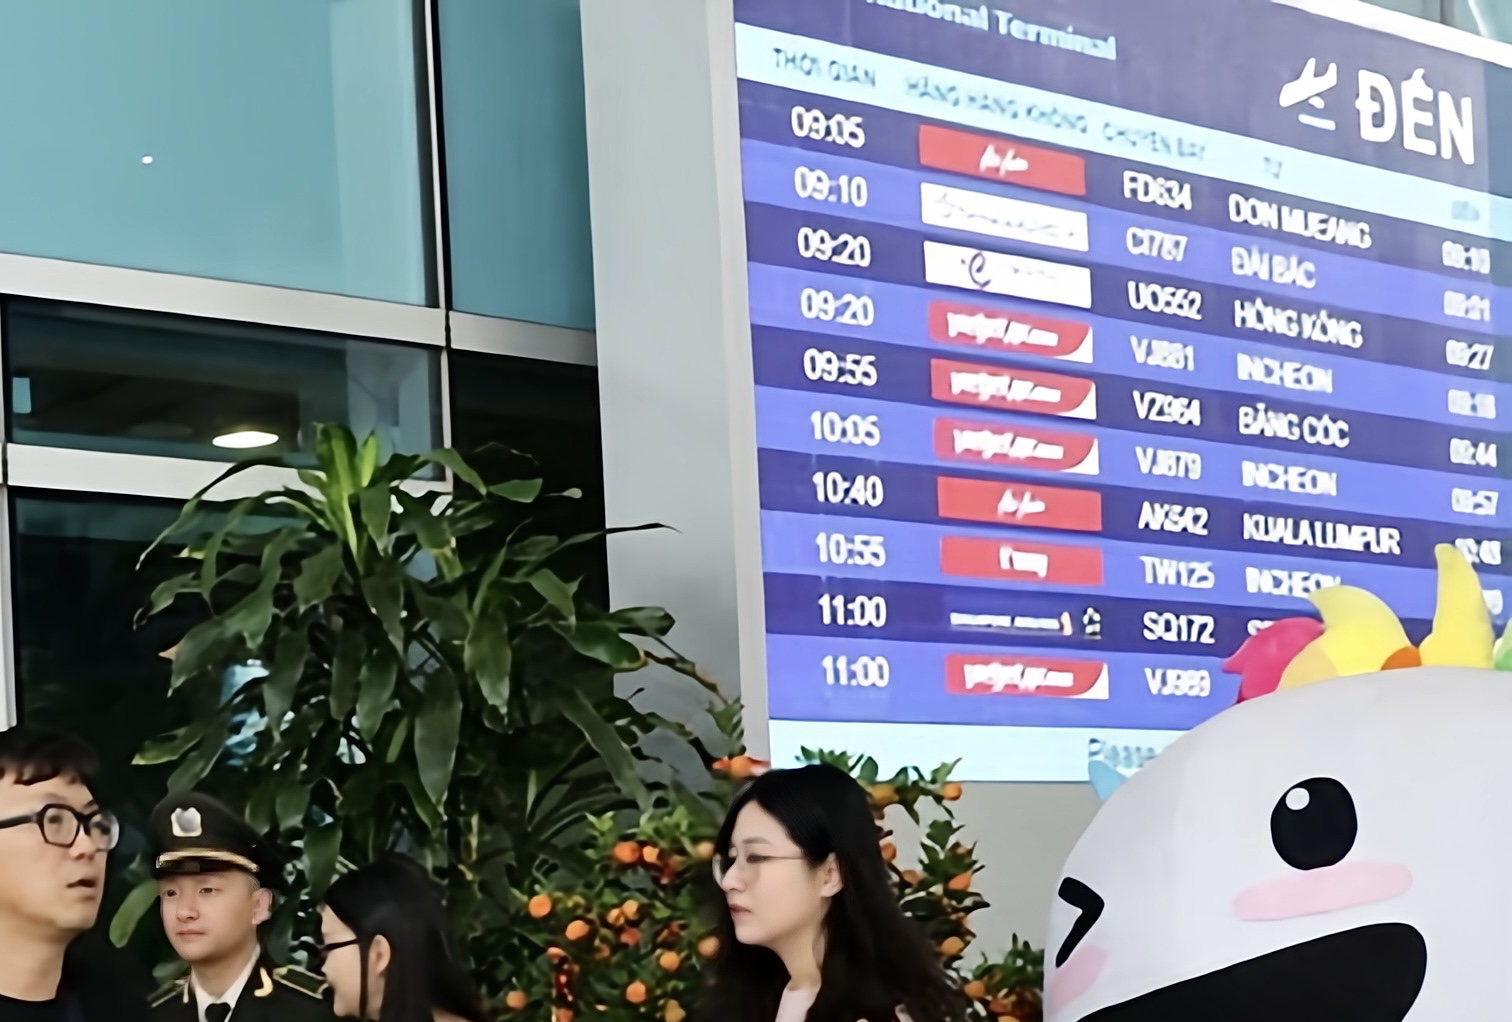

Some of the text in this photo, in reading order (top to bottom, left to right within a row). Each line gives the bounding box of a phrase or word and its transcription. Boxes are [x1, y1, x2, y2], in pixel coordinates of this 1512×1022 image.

[993, 9, 1117, 61] Terminal
[791, 105, 866, 148] 09:05
[1228, 193, 1278, 230] DON
[794, 165, 868, 207] 09:10
[797, 226, 871, 267] 09:20
[800, 287, 875, 327] 09:20
[803, 347, 878, 387] 09:55
[810, 410, 881, 447] 10:05
[812, 471, 885, 508] 10:40
[1243, 513, 1315, 548] KUALA
[815, 531, 887, 568] 10:55
[818, 593, 888, 628] 11:00
[1142, 611, 1216, 645] SQ172
[821, 654, 890, 688] 11:00
